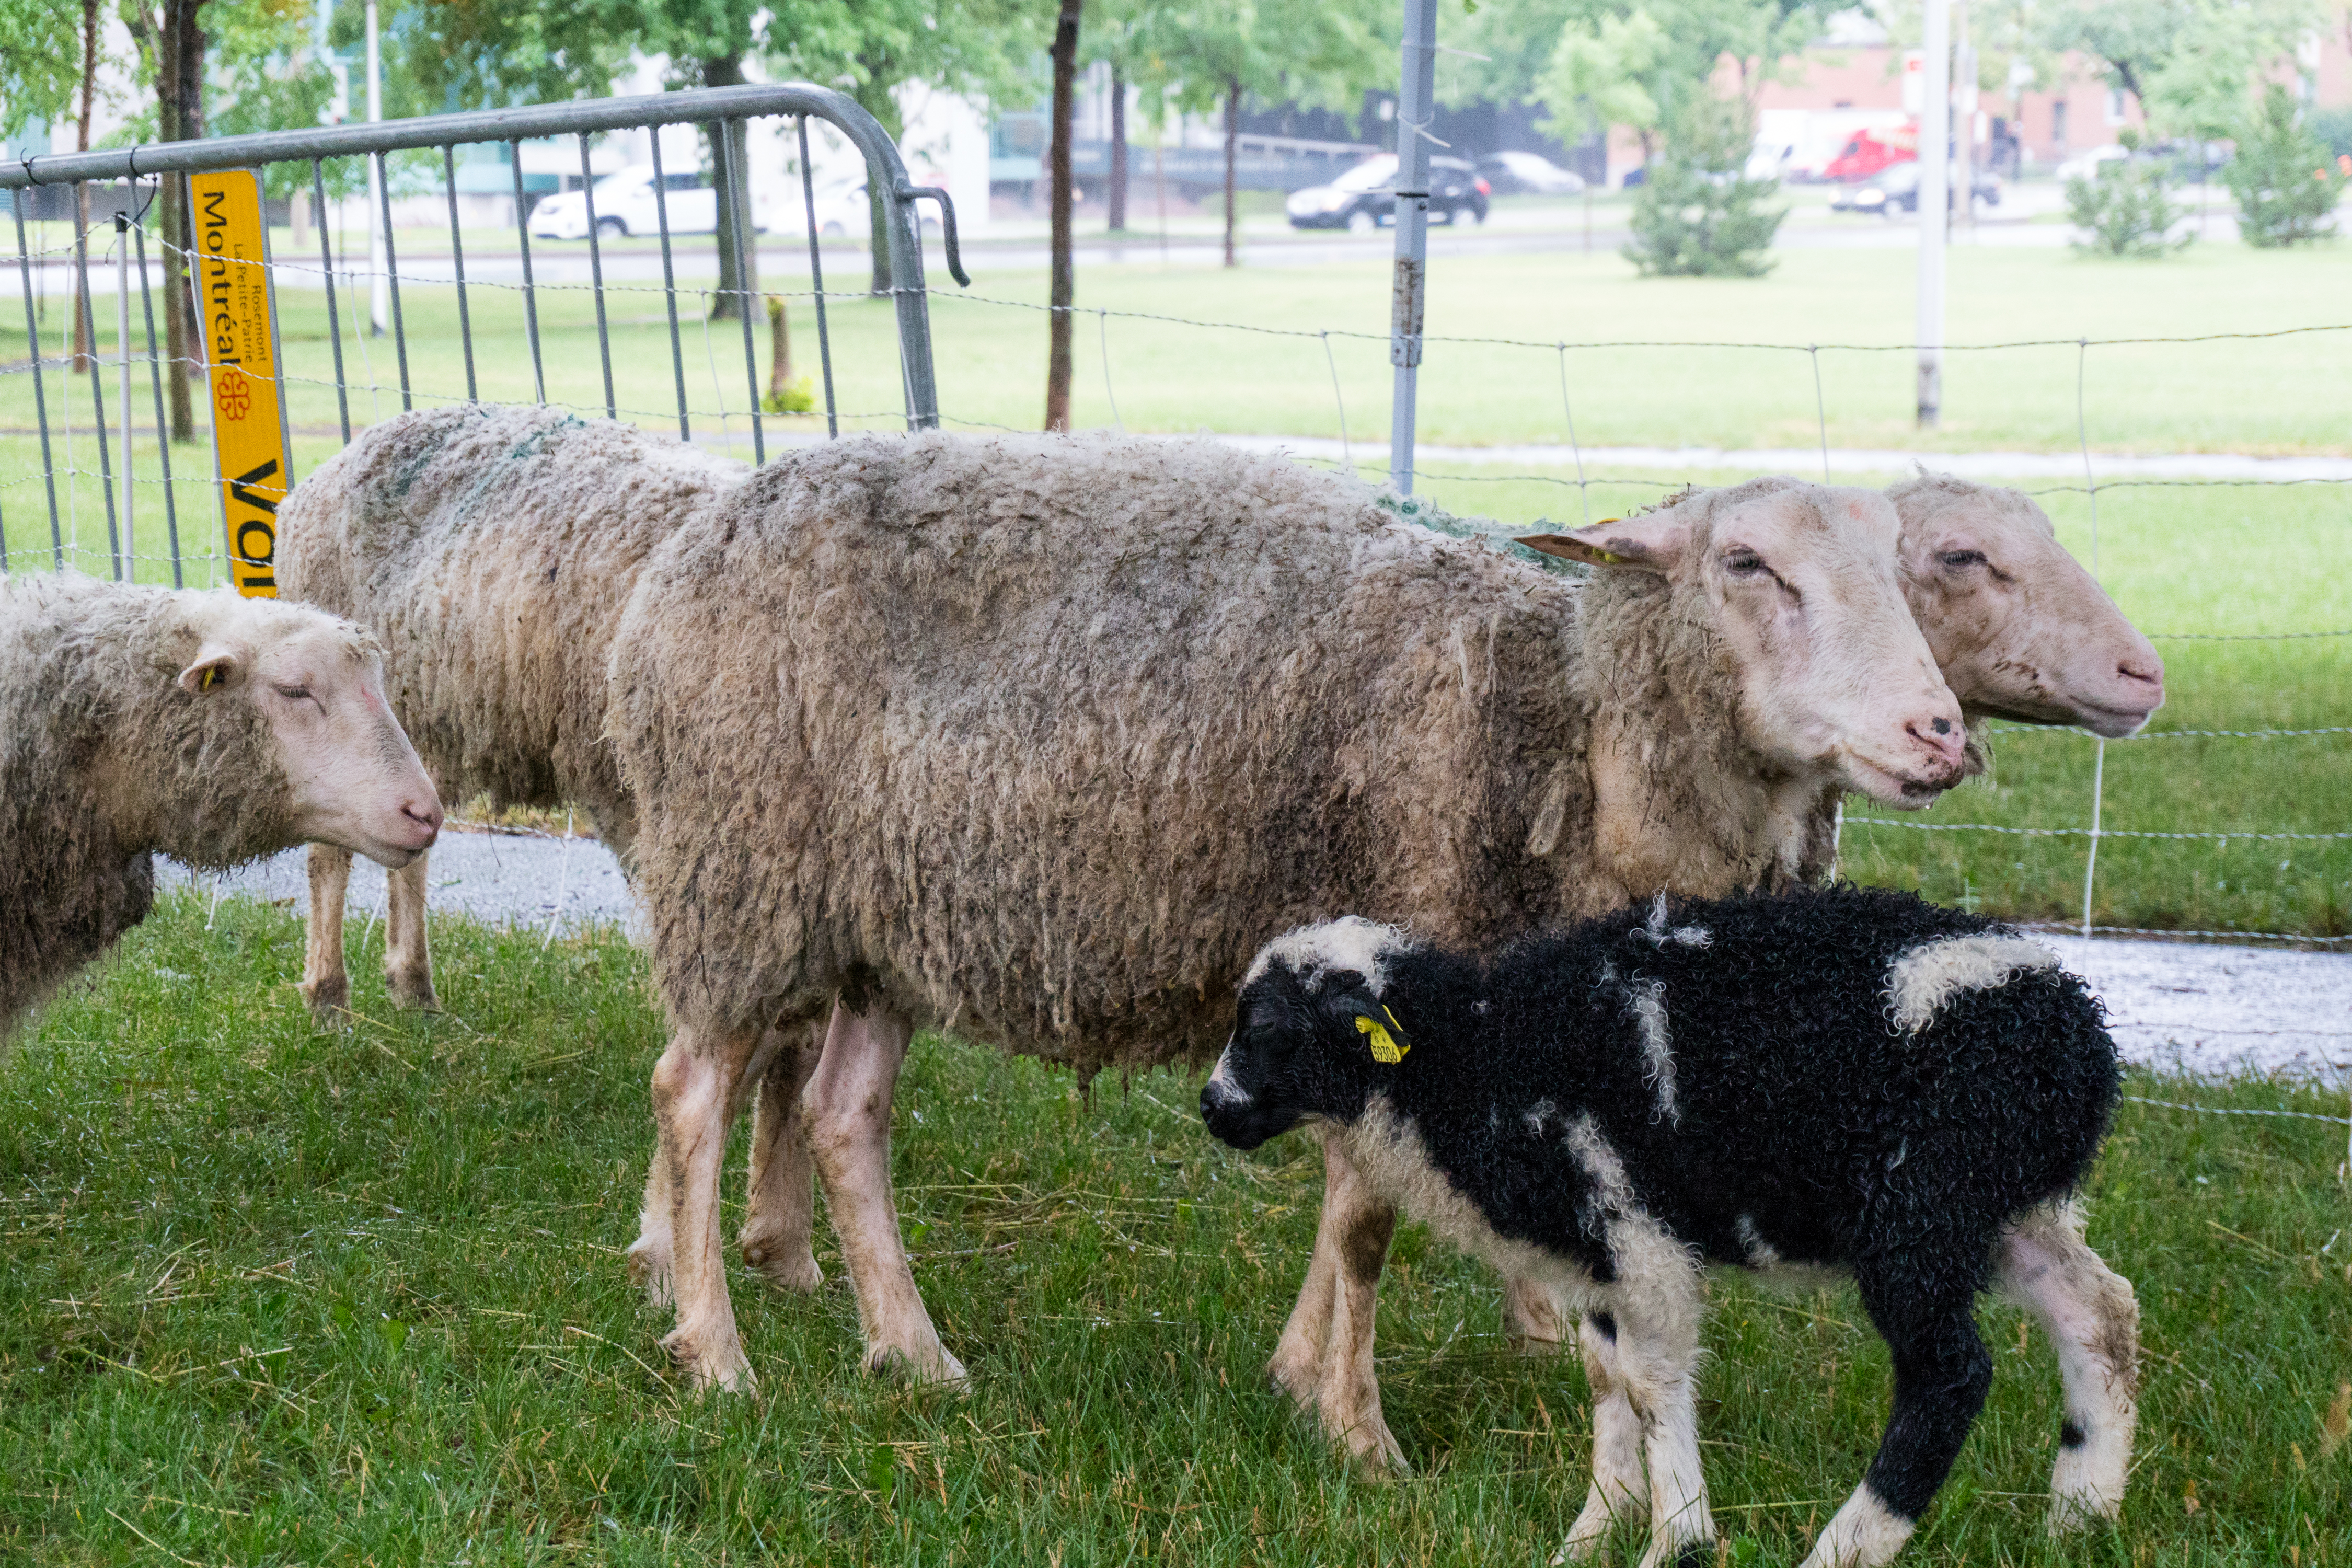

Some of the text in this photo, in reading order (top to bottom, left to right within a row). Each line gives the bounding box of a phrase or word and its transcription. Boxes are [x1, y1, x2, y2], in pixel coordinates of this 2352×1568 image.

[203, 191, 241, 364] Montréal
[234, 244, 253, 363] La Petite-Patrie
[252, 285, 267, 361] Rosemont
[1373, 1046, 1398, 1062] 59306
